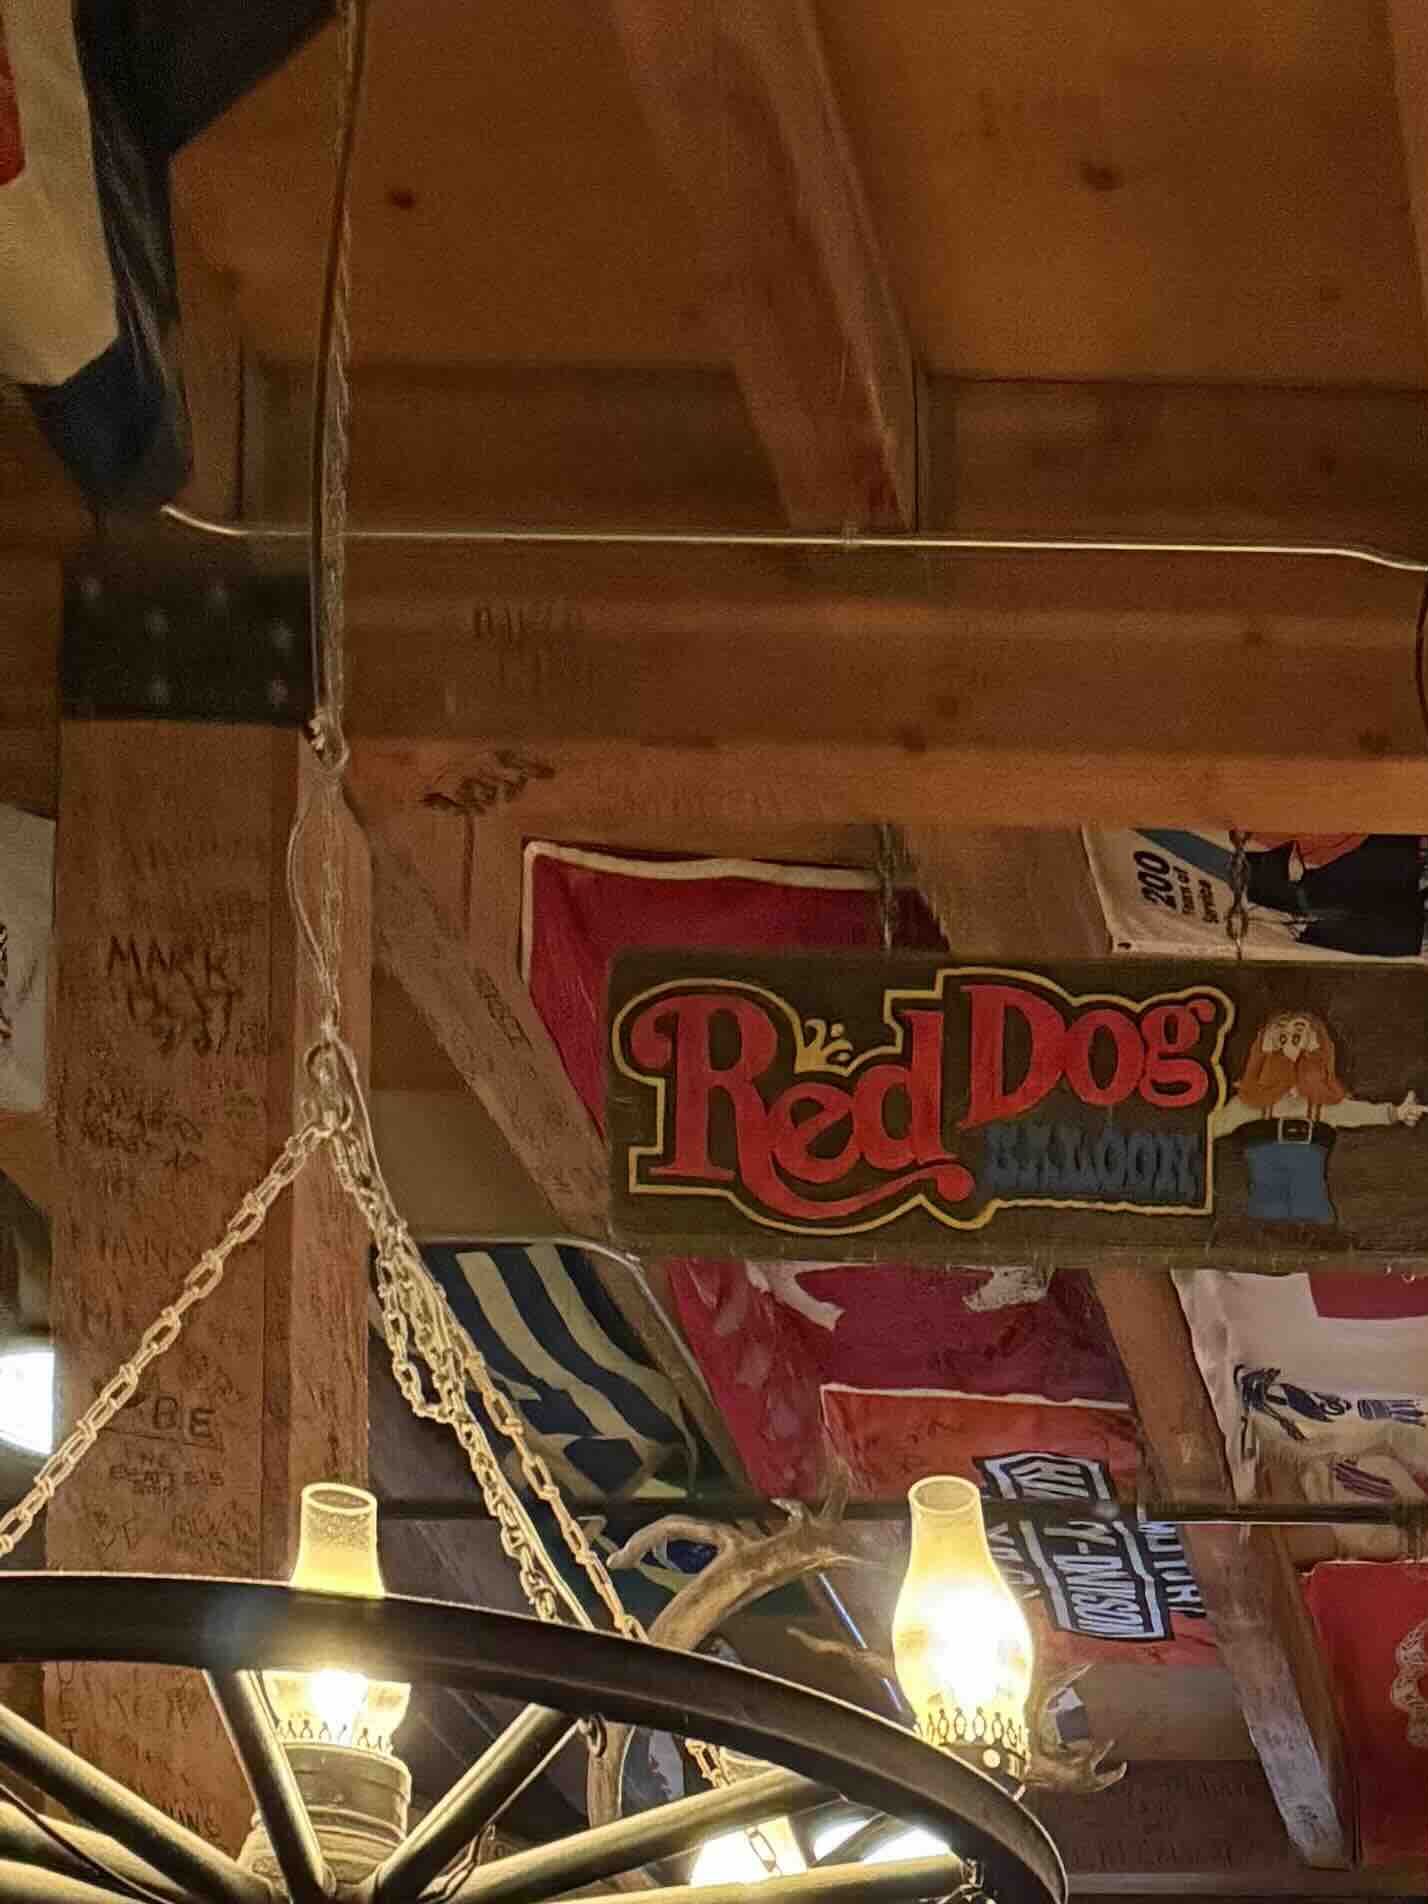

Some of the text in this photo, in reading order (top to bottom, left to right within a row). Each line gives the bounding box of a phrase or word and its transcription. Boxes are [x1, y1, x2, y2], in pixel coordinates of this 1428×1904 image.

[630, 983, 1216, 1221] Red Dog
[982, 1122, 1206, 1201] SALOON
